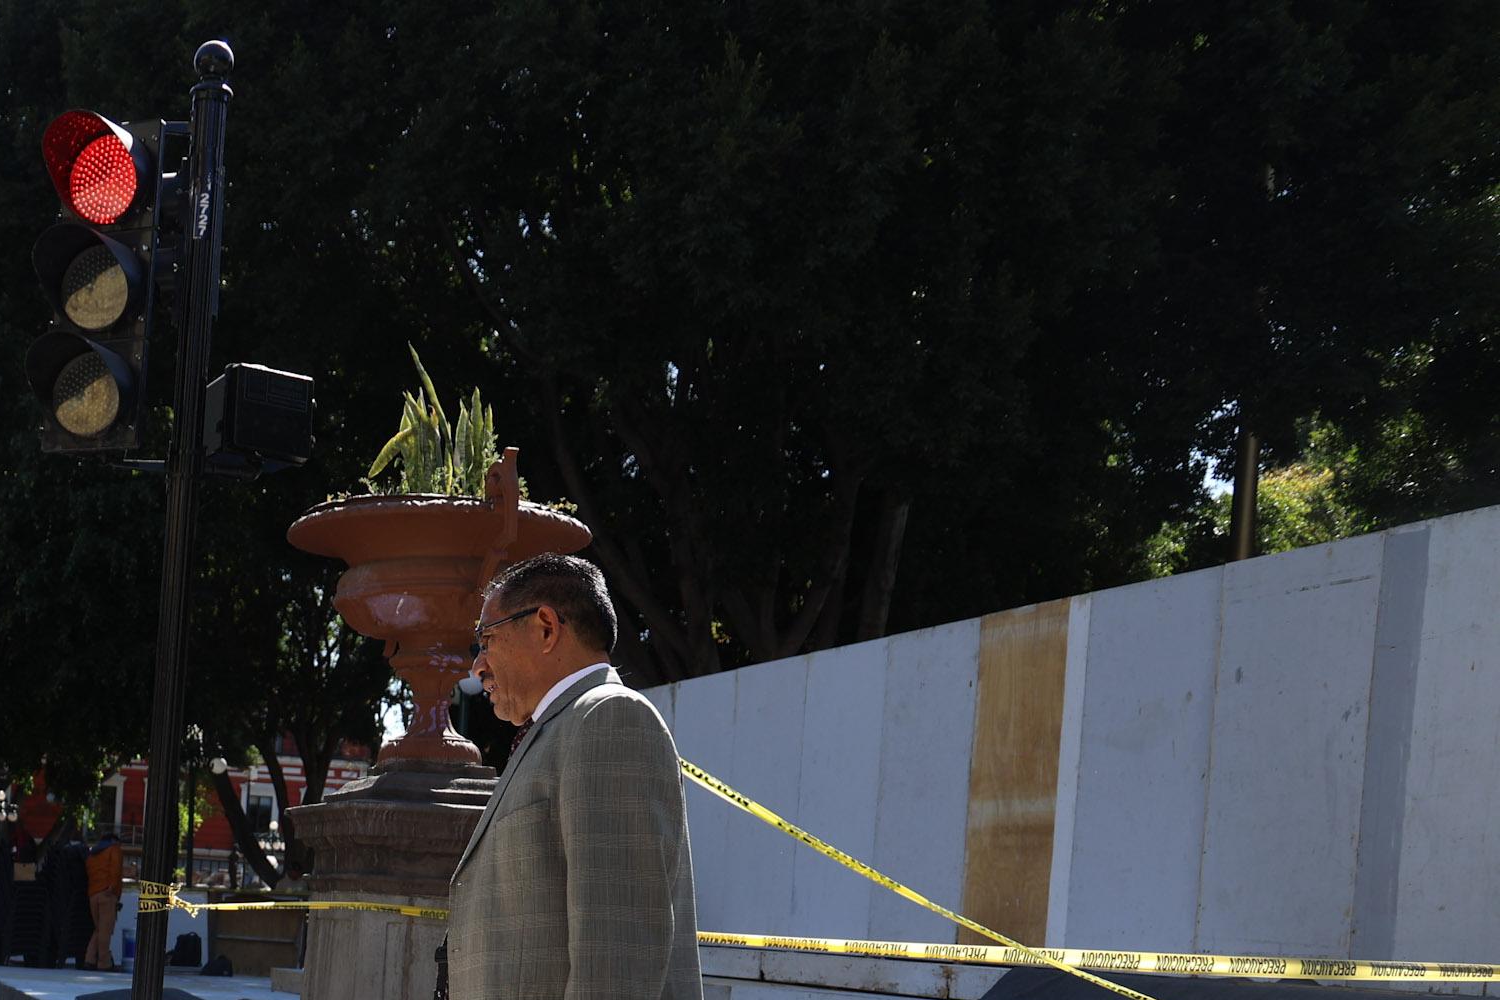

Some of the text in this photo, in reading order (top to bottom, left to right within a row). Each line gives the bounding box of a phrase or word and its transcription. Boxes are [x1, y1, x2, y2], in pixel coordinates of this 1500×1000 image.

[924, 945, 988, 961] PRECAUCION
[1081, 952, 1141, 970] PRECAUCION
[1155, 955, 1215, 973] PRECAUCION
[1229, 957, 1287, 974] PRECAUCION
[1300, 959, 1357, 976] PRECAUCION
